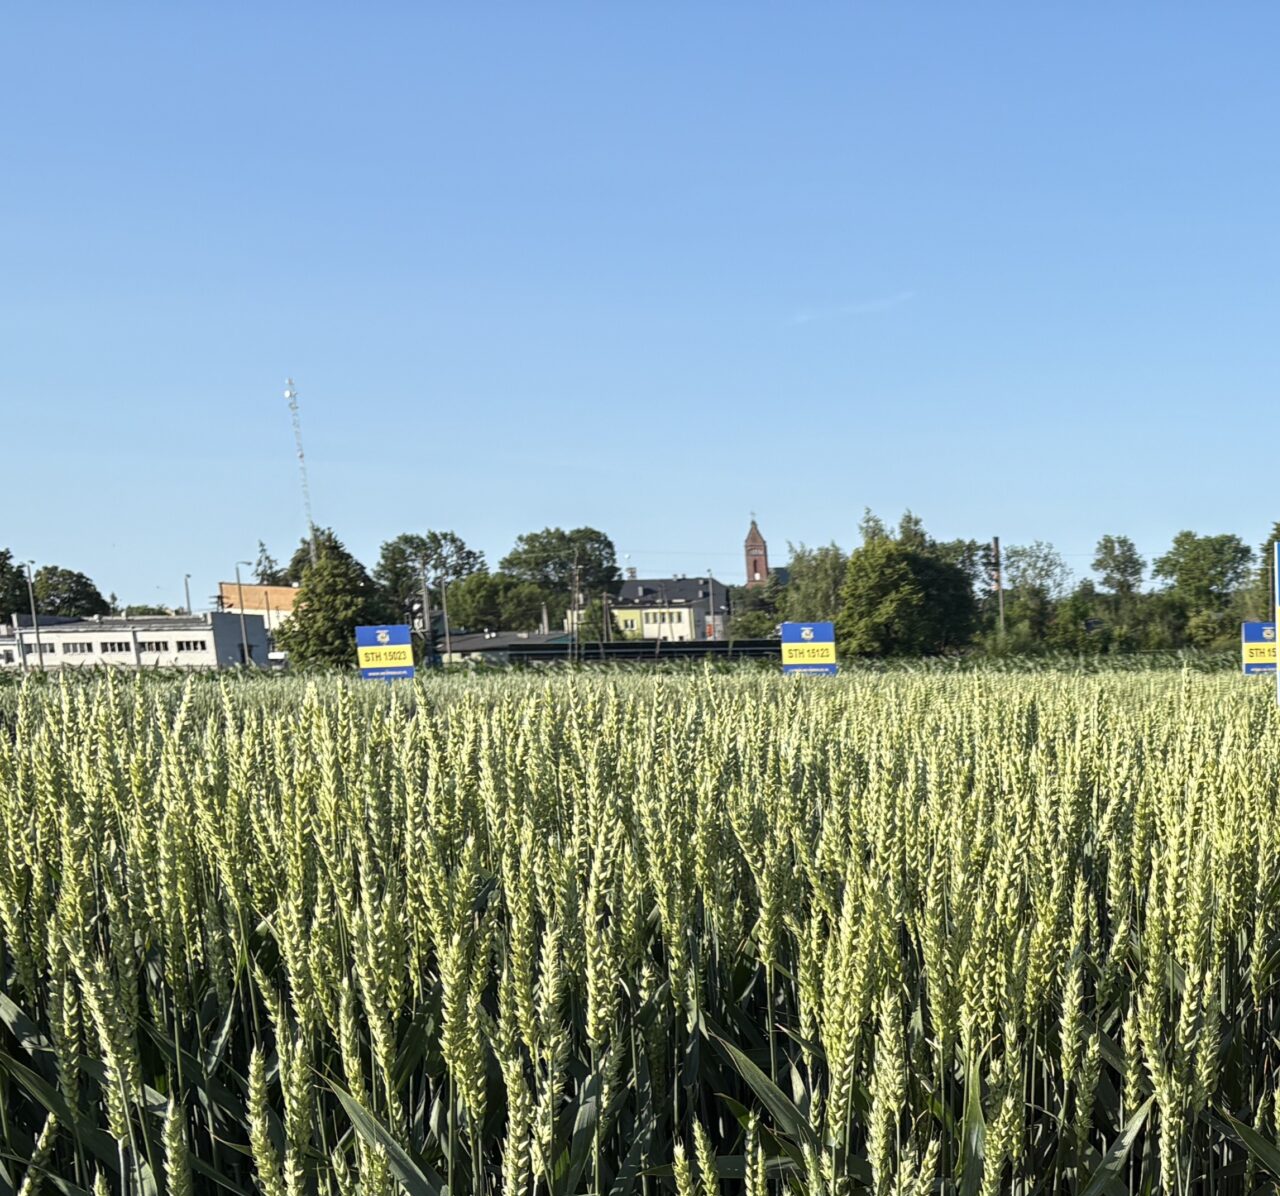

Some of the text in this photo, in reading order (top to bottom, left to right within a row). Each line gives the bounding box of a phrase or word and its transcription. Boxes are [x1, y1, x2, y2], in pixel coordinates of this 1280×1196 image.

[364, 652, 382, 662] STH
[788, 648, 805, 659] STH
[1249, 648, 1265, 658] STH
